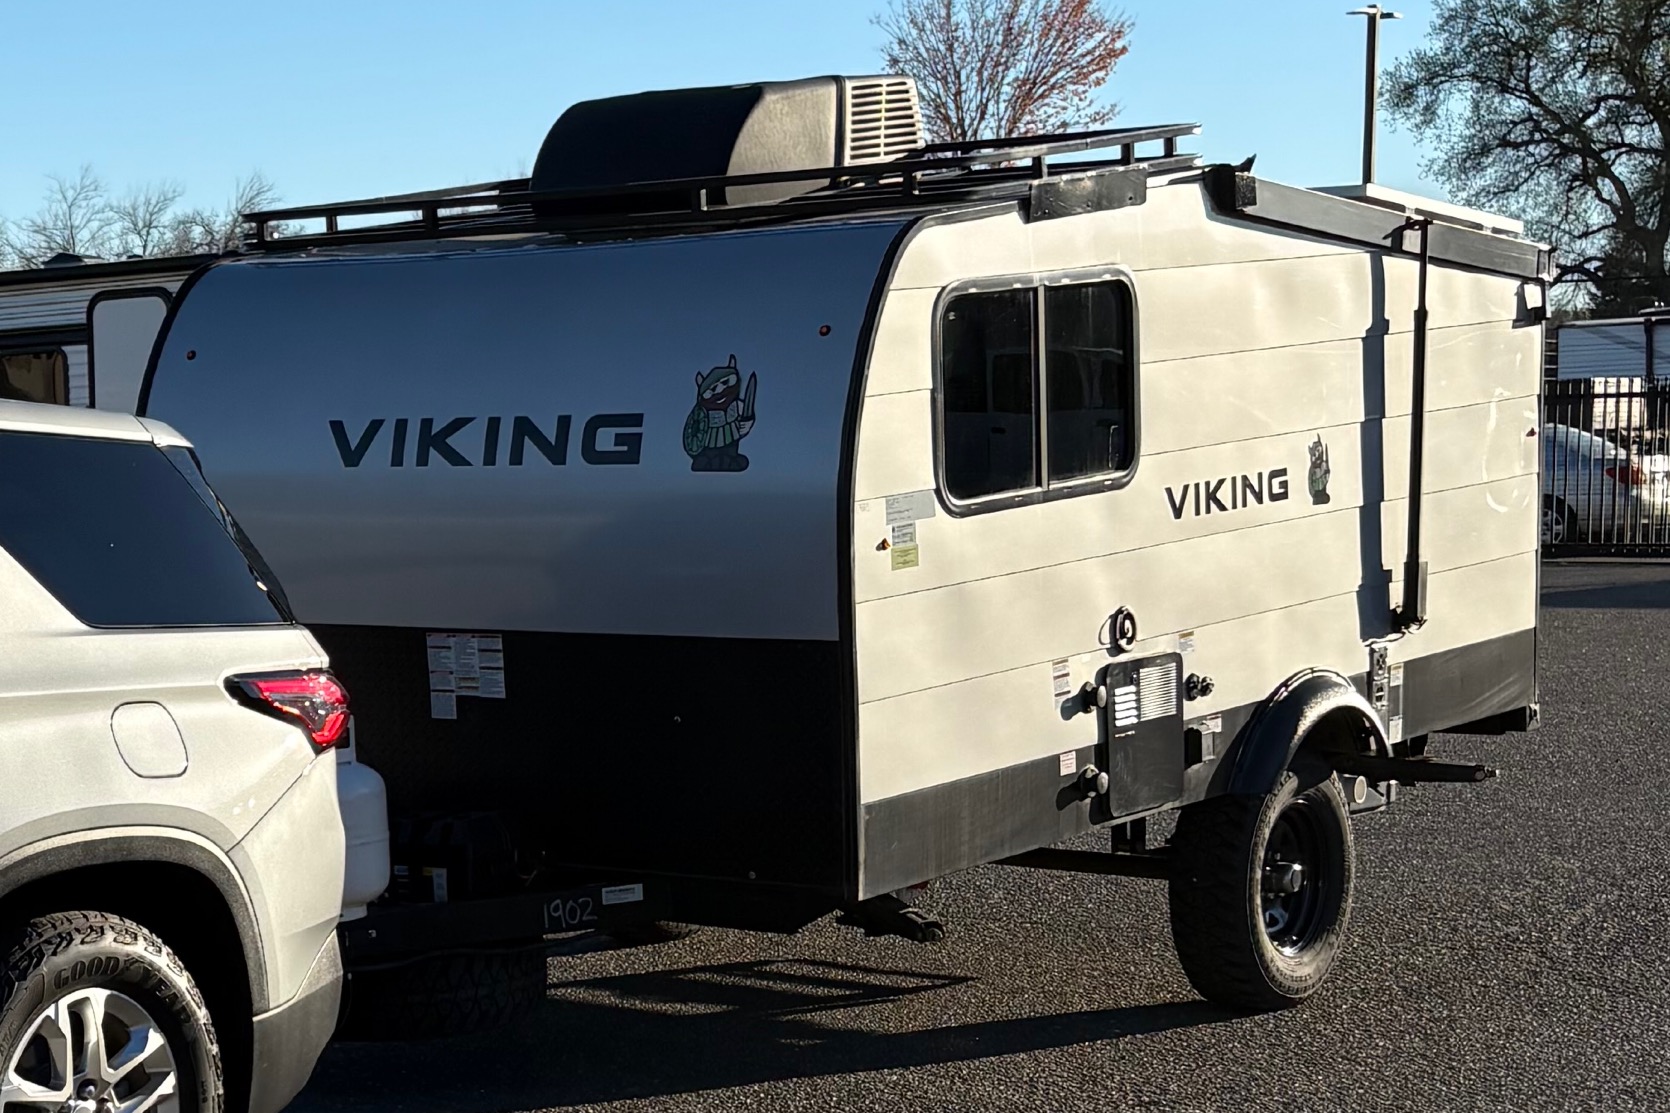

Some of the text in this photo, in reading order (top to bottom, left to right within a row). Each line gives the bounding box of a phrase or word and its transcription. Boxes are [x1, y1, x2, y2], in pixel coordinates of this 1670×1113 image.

[329, 413, 645, 467] VIKING
[1165, 467, 1289, 520] VIKING
[543, 897, 598, 928] 1902
[53, 956, 120, 990] GOOD
